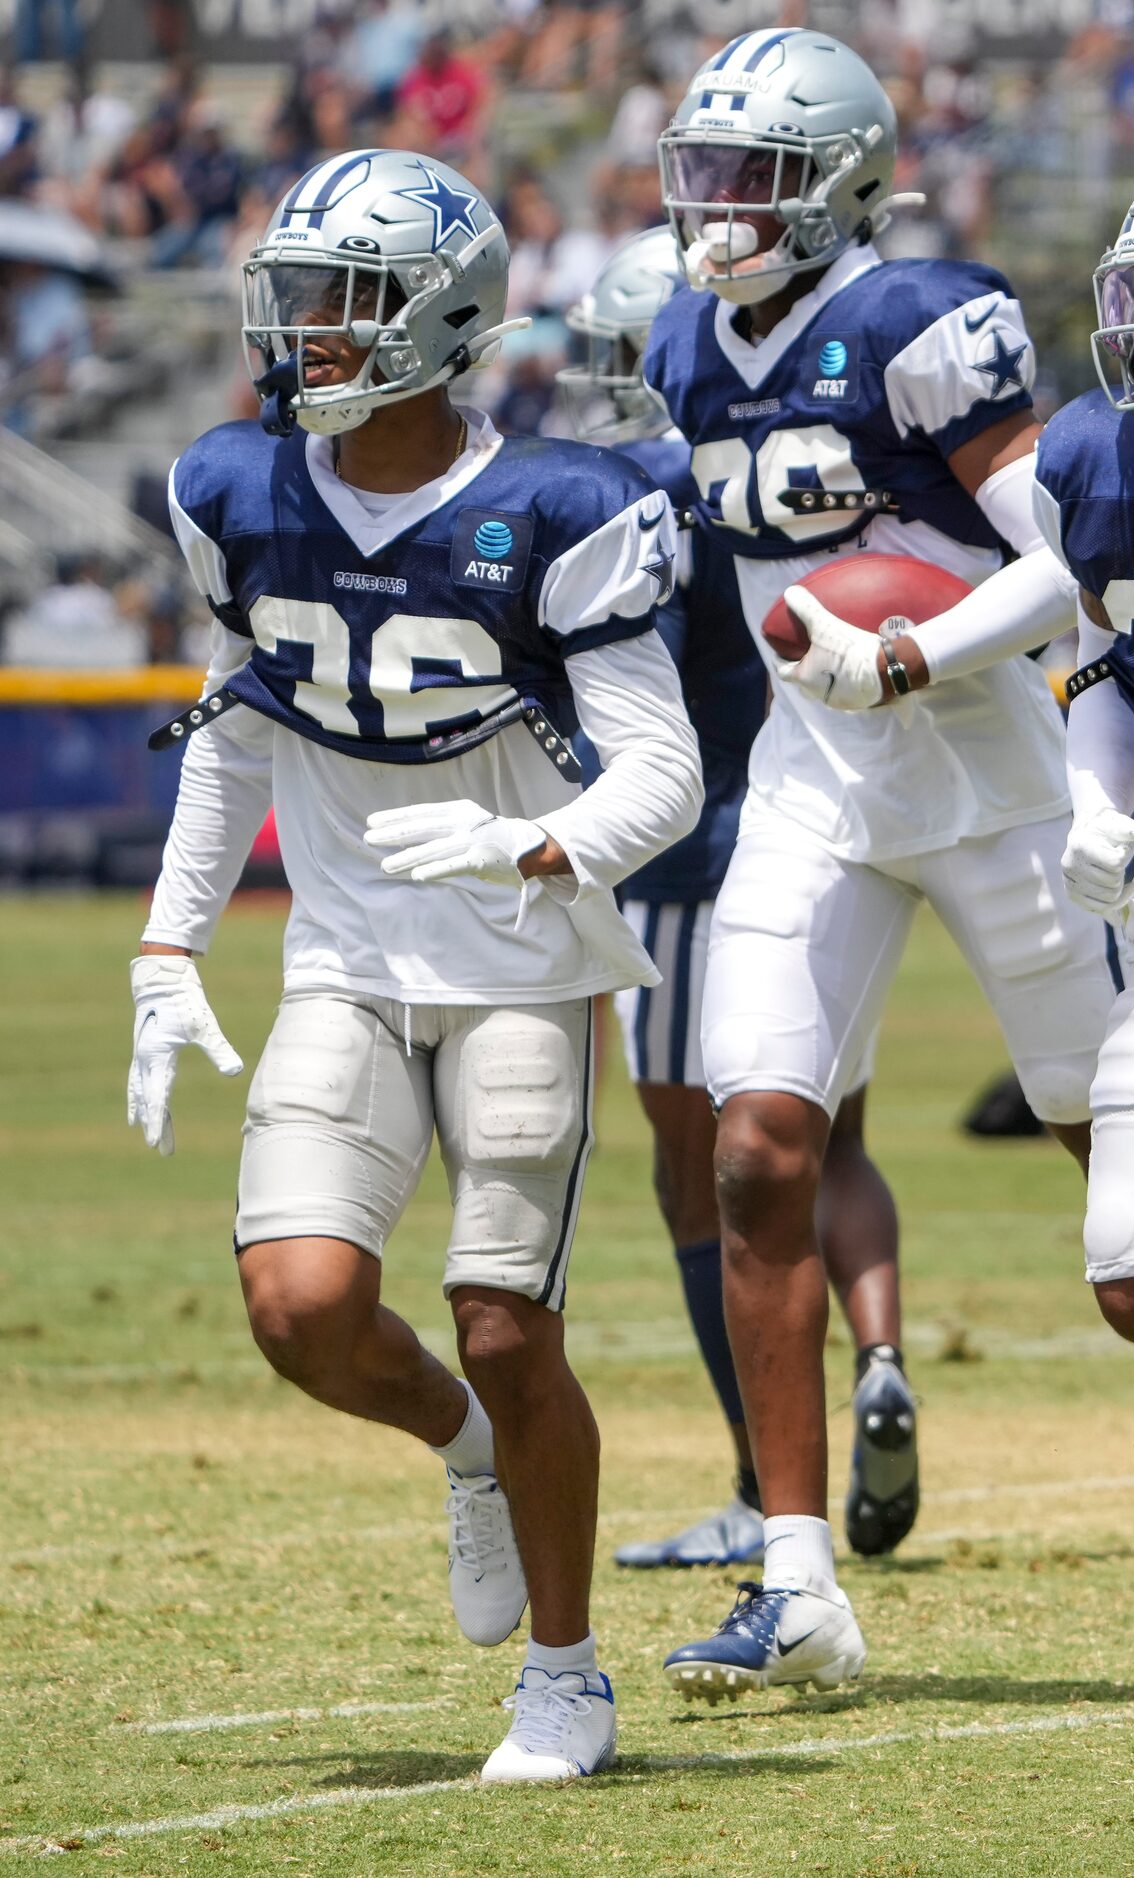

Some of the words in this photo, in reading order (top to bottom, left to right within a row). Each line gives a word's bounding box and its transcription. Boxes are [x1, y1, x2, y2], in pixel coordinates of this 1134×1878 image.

[813, 379, 848, 398] AT&T
[728, 398, 780, 418] COWBOYS
[333, 571, 408, 594] COWBOYS
[464, 561, 514, 583] AT&T
